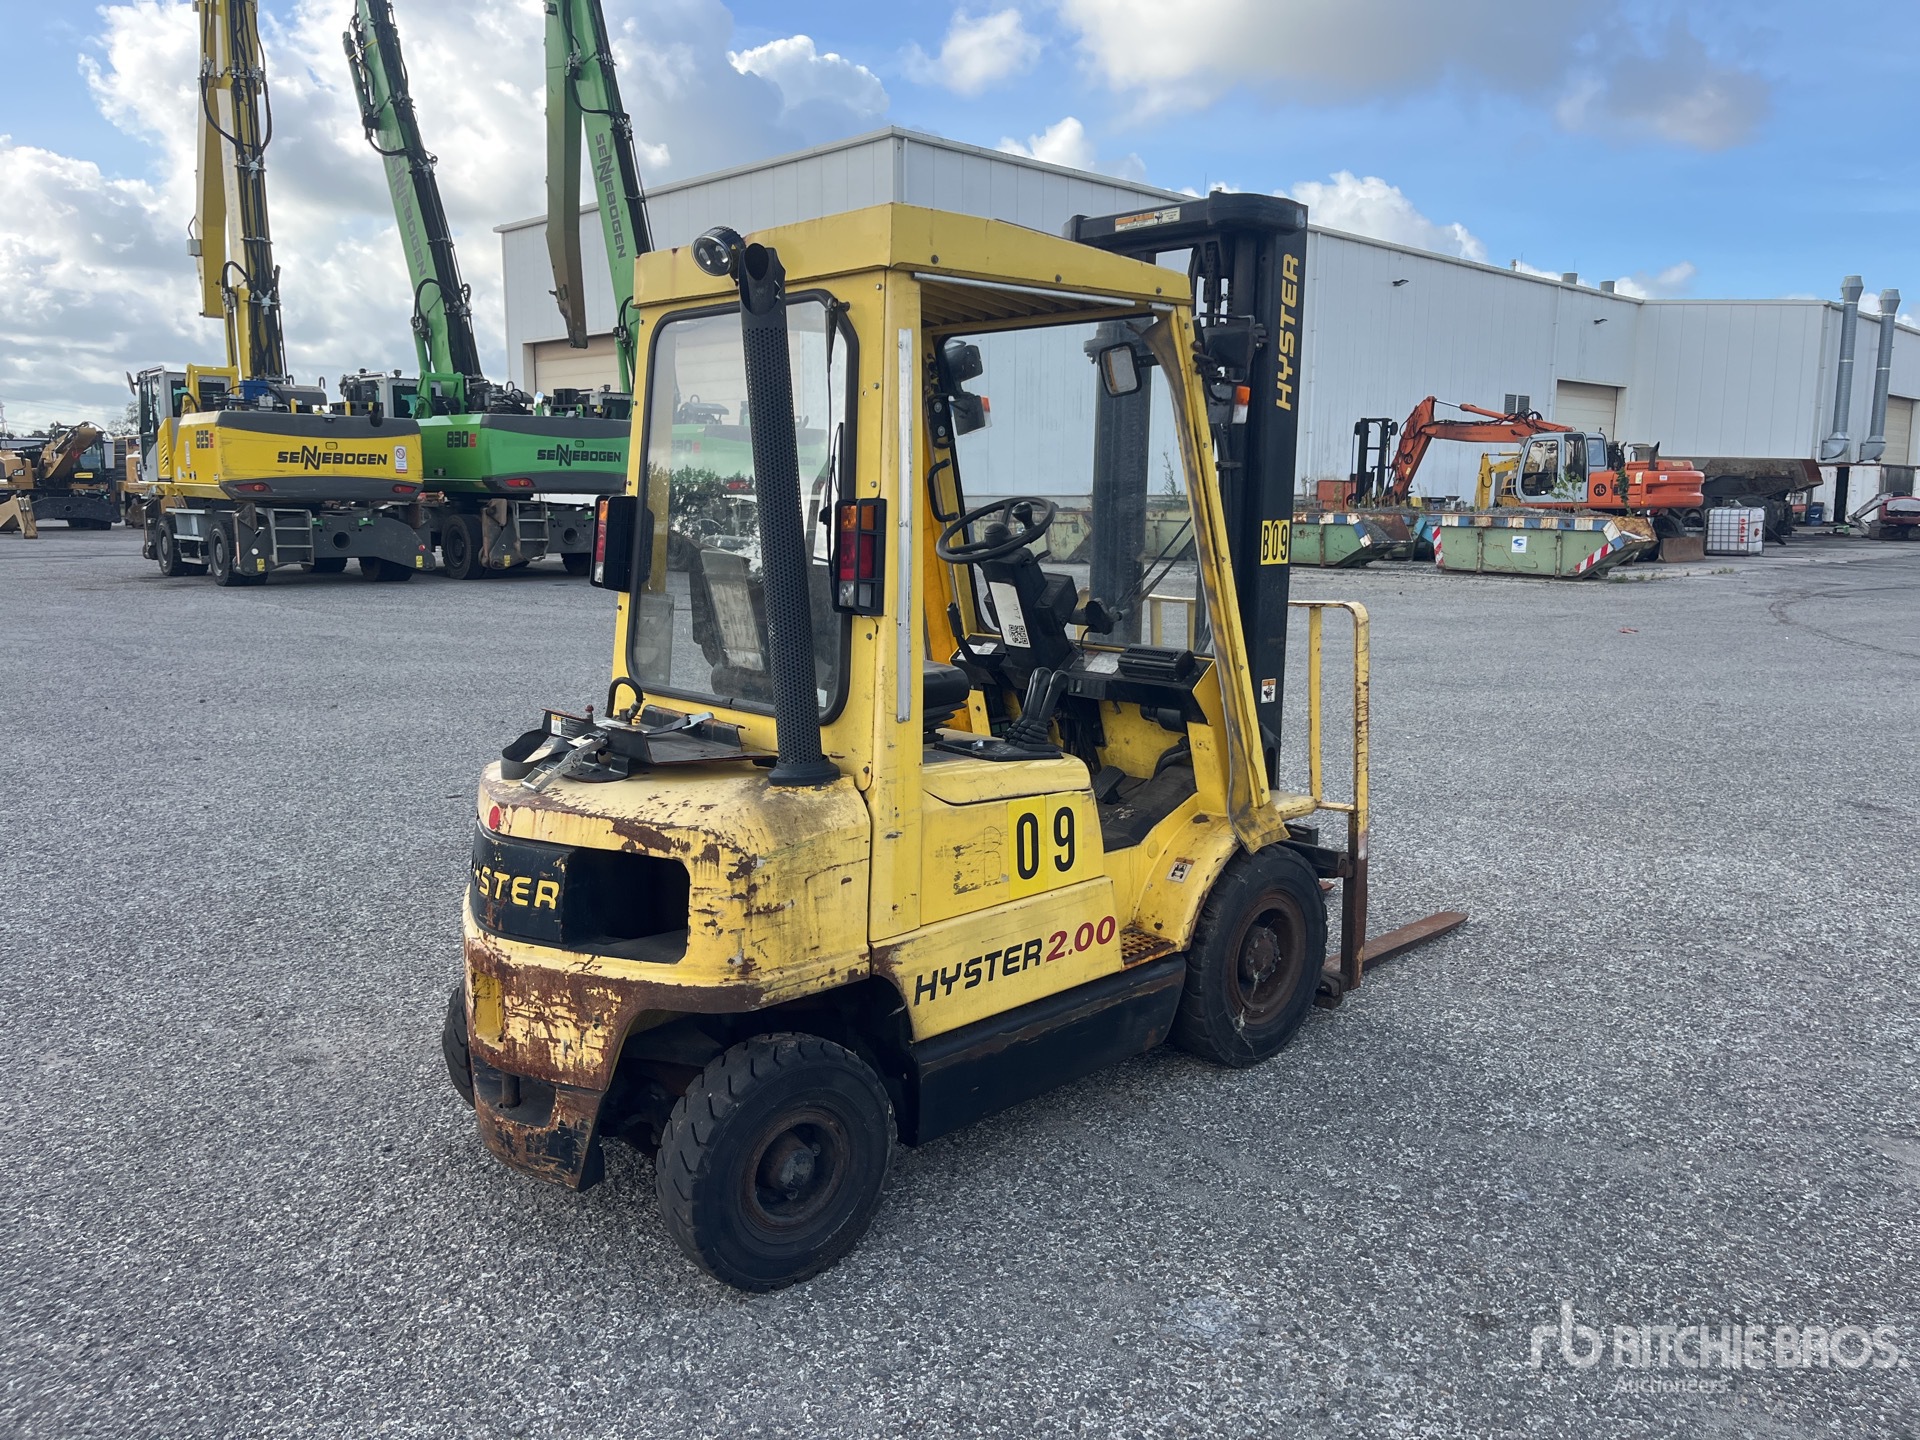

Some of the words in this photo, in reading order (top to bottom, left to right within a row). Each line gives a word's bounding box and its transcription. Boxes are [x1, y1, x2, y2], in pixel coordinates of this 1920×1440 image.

[595, 132, 626, 259] SENNEBOGEN
[1276, 253, 1299, 411] HYSTER
[277, 445, 388, 470] SENNEBOGEN
[446, 431, 477, 448] 830E
[537, 444, 621, 466] SENNEBOGEN
[1262, 523, 1288, 561] B09
[914, 938, 1043, 1006] HYSTER
[1045, 915, 1116, 963] 2.00
